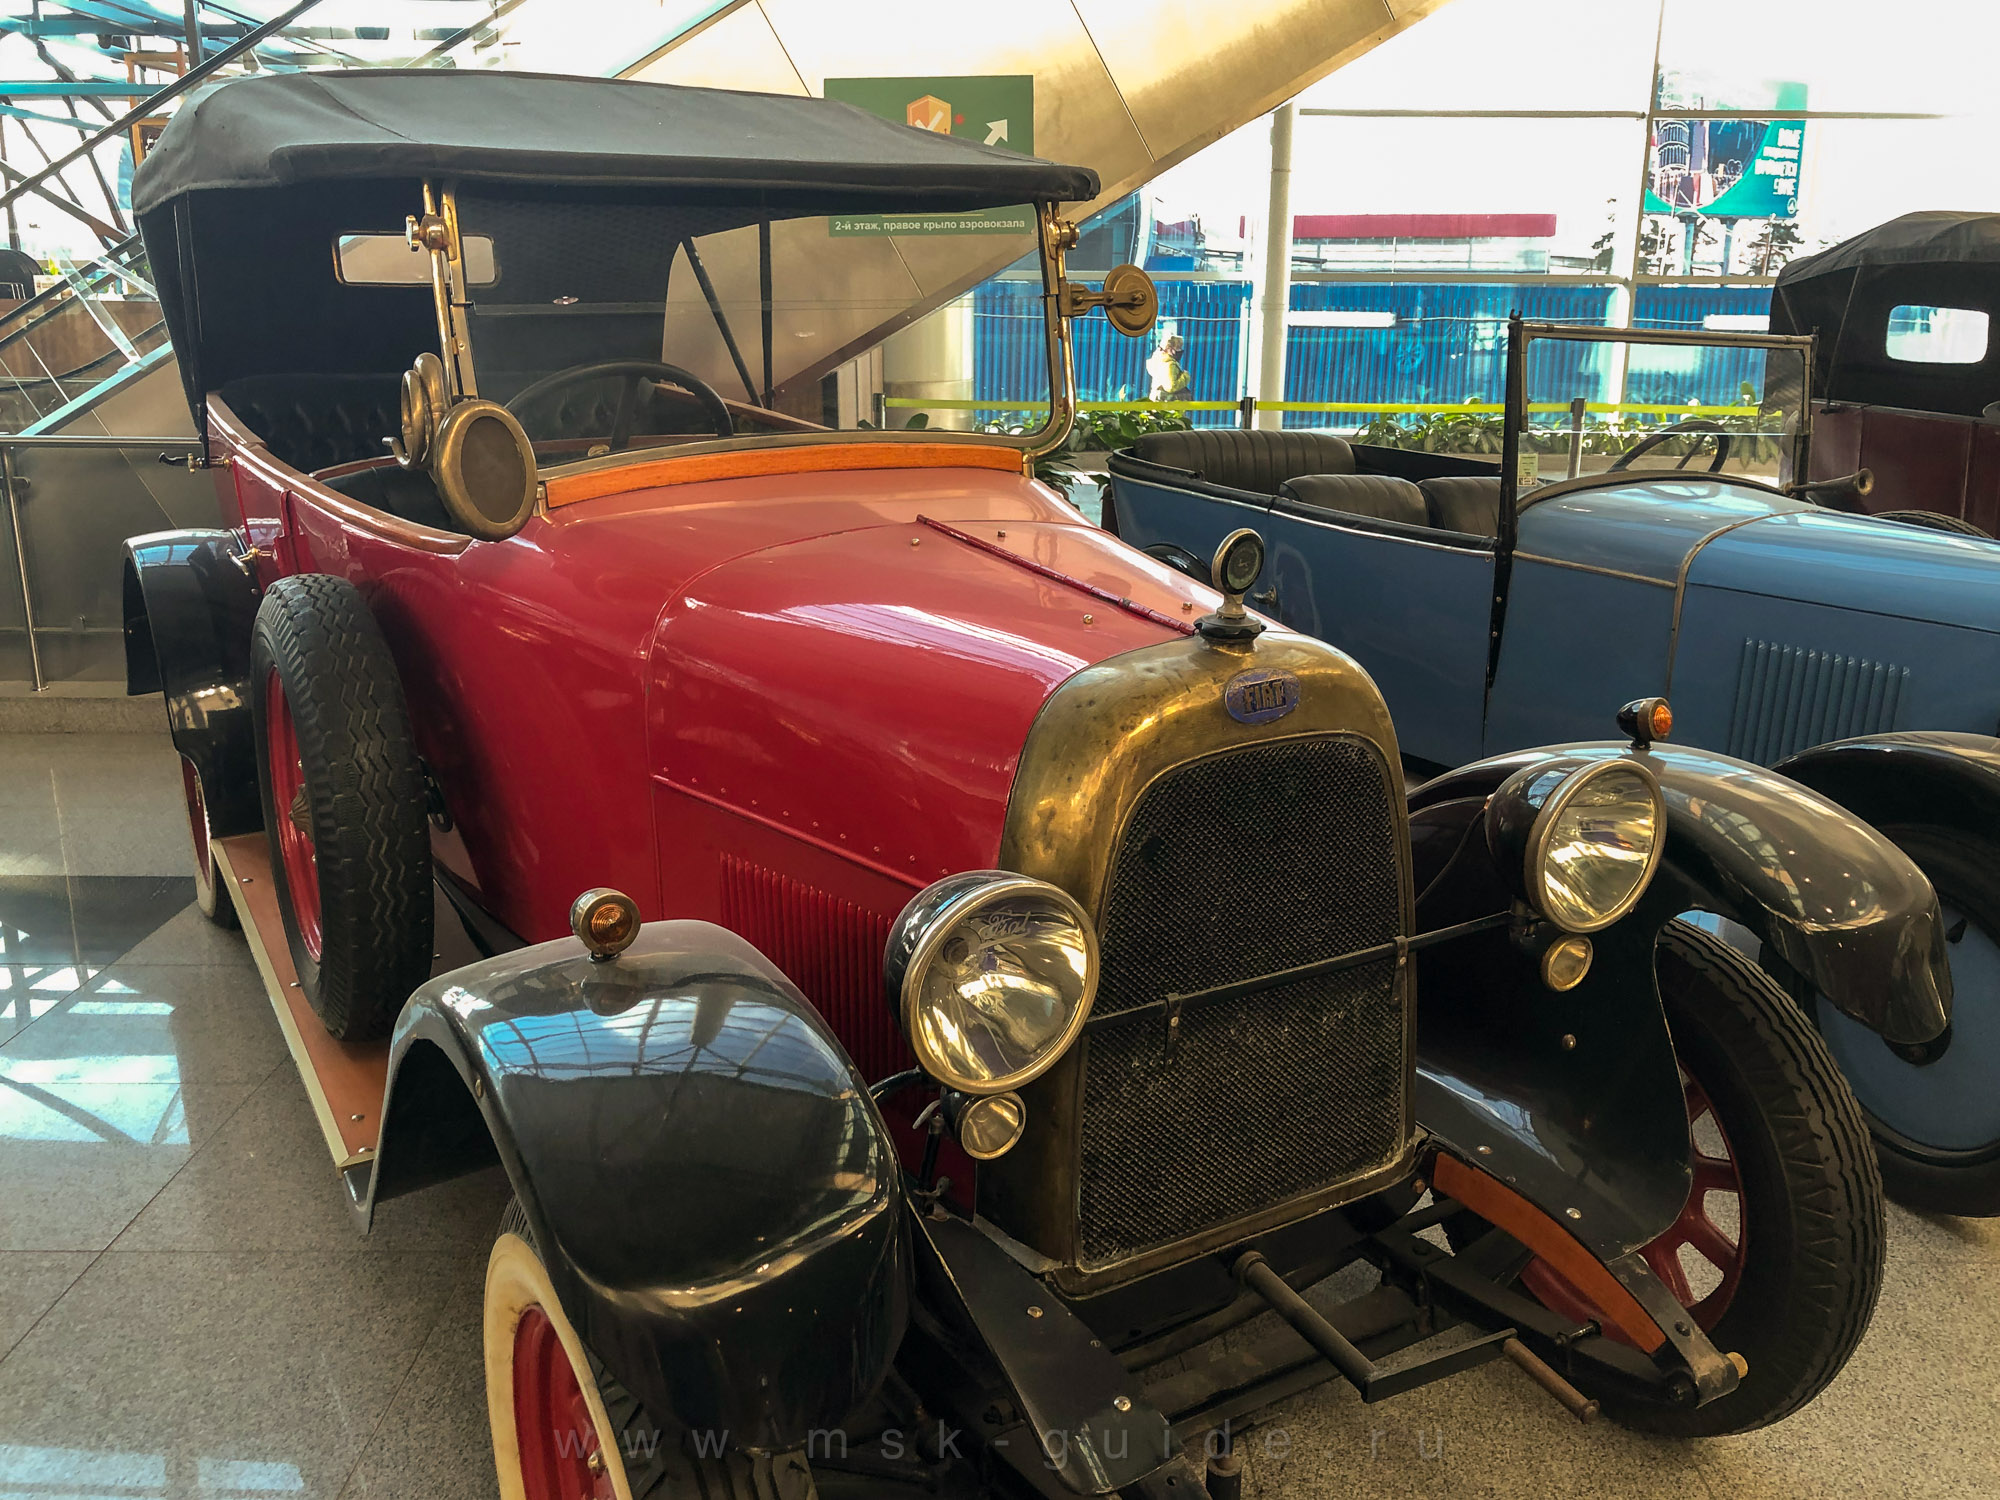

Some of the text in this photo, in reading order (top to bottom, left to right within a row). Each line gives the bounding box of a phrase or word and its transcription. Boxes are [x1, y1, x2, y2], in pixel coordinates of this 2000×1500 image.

[835, 220, 1025, 232] 2-й этаж, правое крыло аэровокзала
[1244, 681, 1284, 713] FIAT
